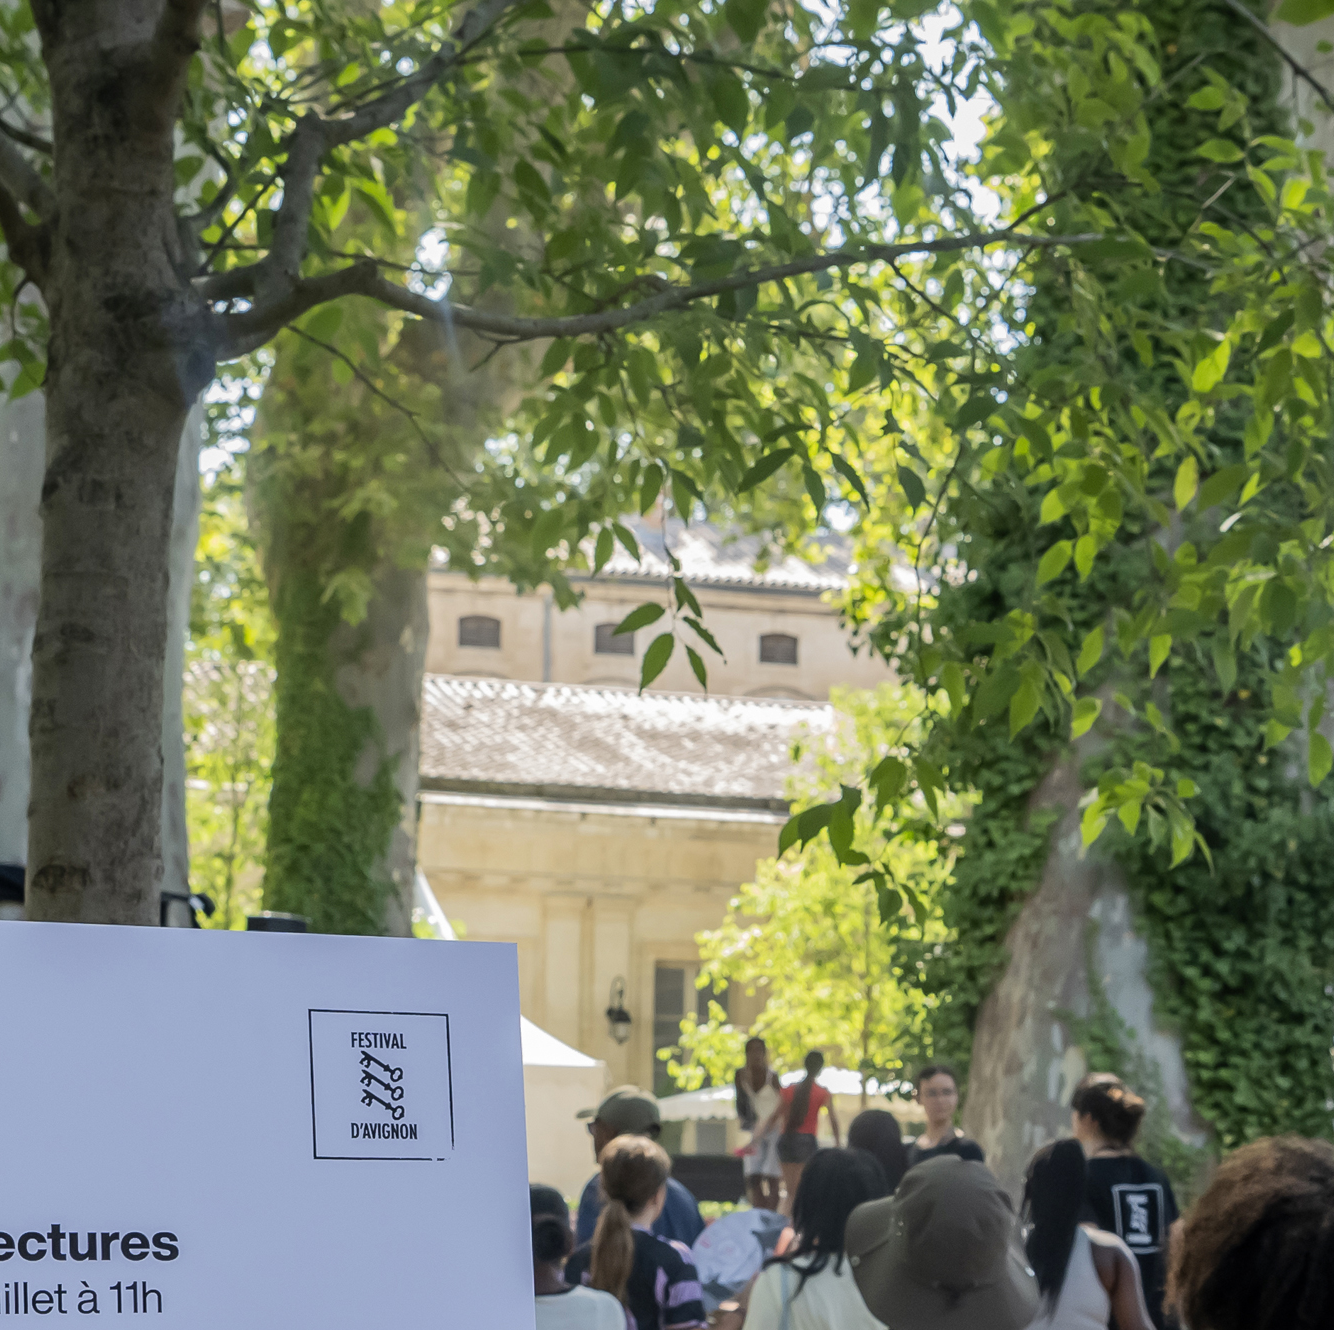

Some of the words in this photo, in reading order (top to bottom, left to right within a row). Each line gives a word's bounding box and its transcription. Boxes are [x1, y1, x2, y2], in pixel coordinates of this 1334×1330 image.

[351, 1032, 407, 1049] FESTIVAL
[351, 1123, 418, 1140] D'AVIGNON
[78, 1281, 100, 1314] à
[110, 1281, 162, 1313] 11h
